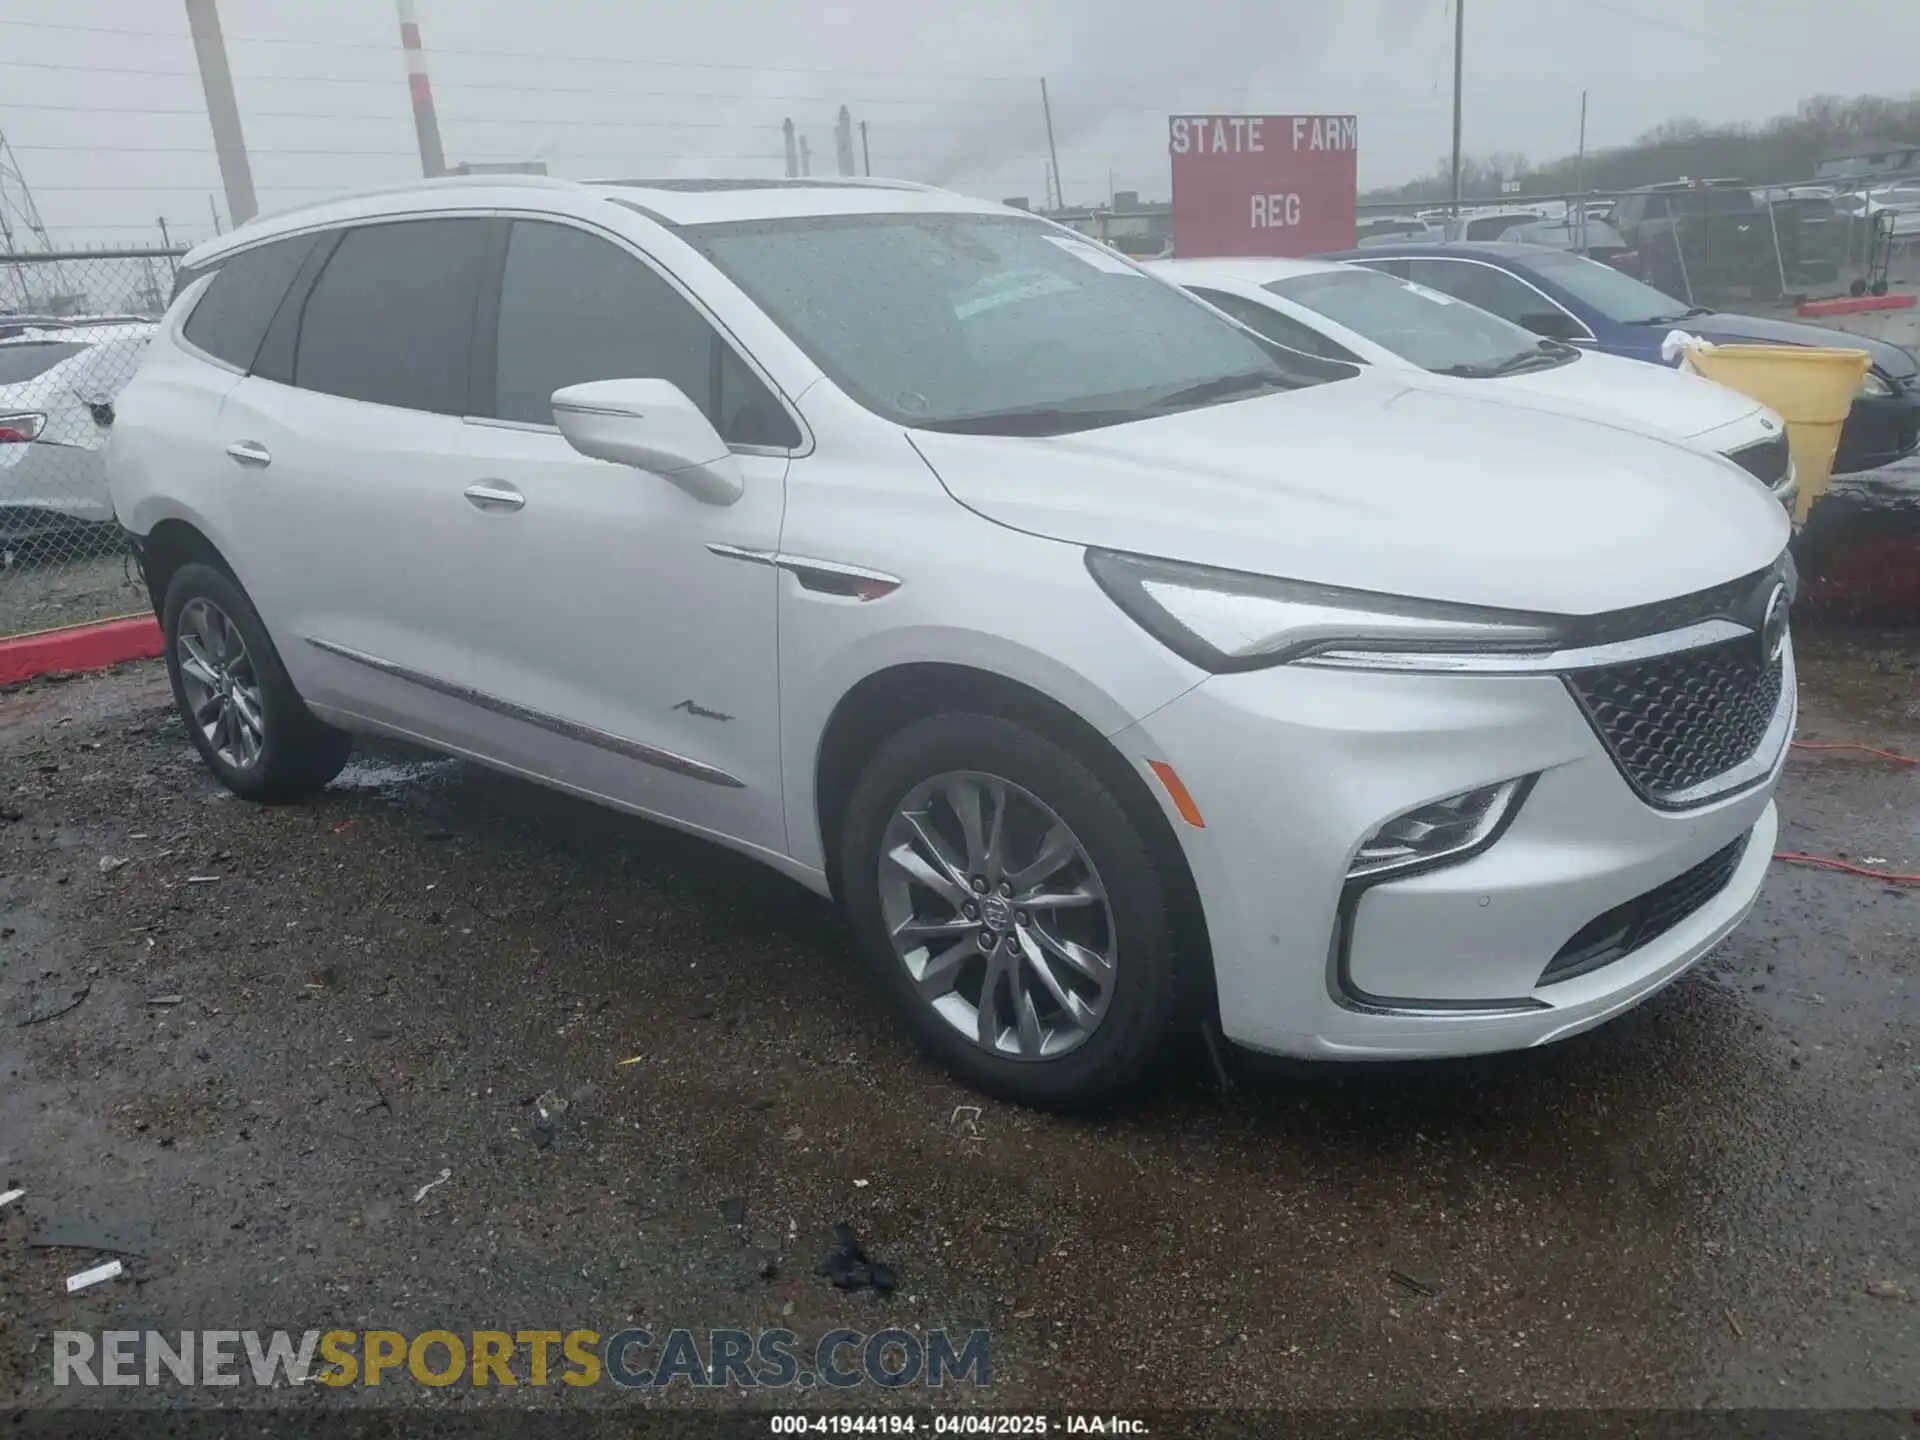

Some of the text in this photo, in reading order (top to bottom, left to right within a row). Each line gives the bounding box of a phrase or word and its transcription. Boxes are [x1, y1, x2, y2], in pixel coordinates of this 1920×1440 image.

[1171, 116, 1357, 154] STATE FARM
[1251, 193, 1301, 229] REG
